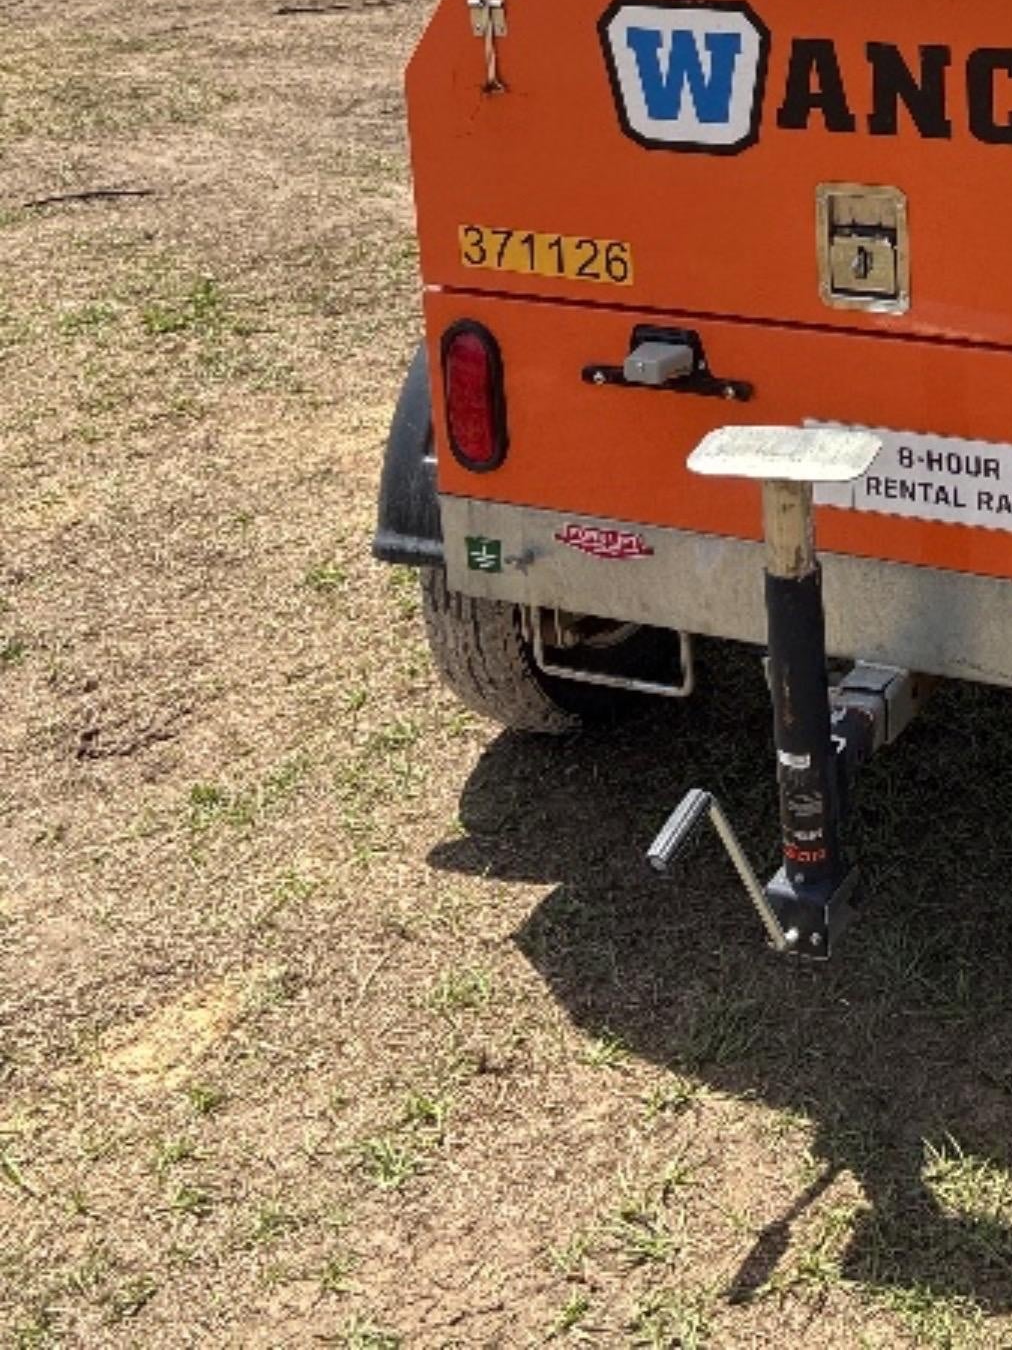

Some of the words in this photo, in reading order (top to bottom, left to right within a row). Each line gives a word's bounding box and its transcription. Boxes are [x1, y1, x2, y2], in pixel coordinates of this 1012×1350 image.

[464, 225, 628, 282] 371126
[899, 447, 1000, 480] 8-HOUR
[866, 477, 967, 509] RENTAL
